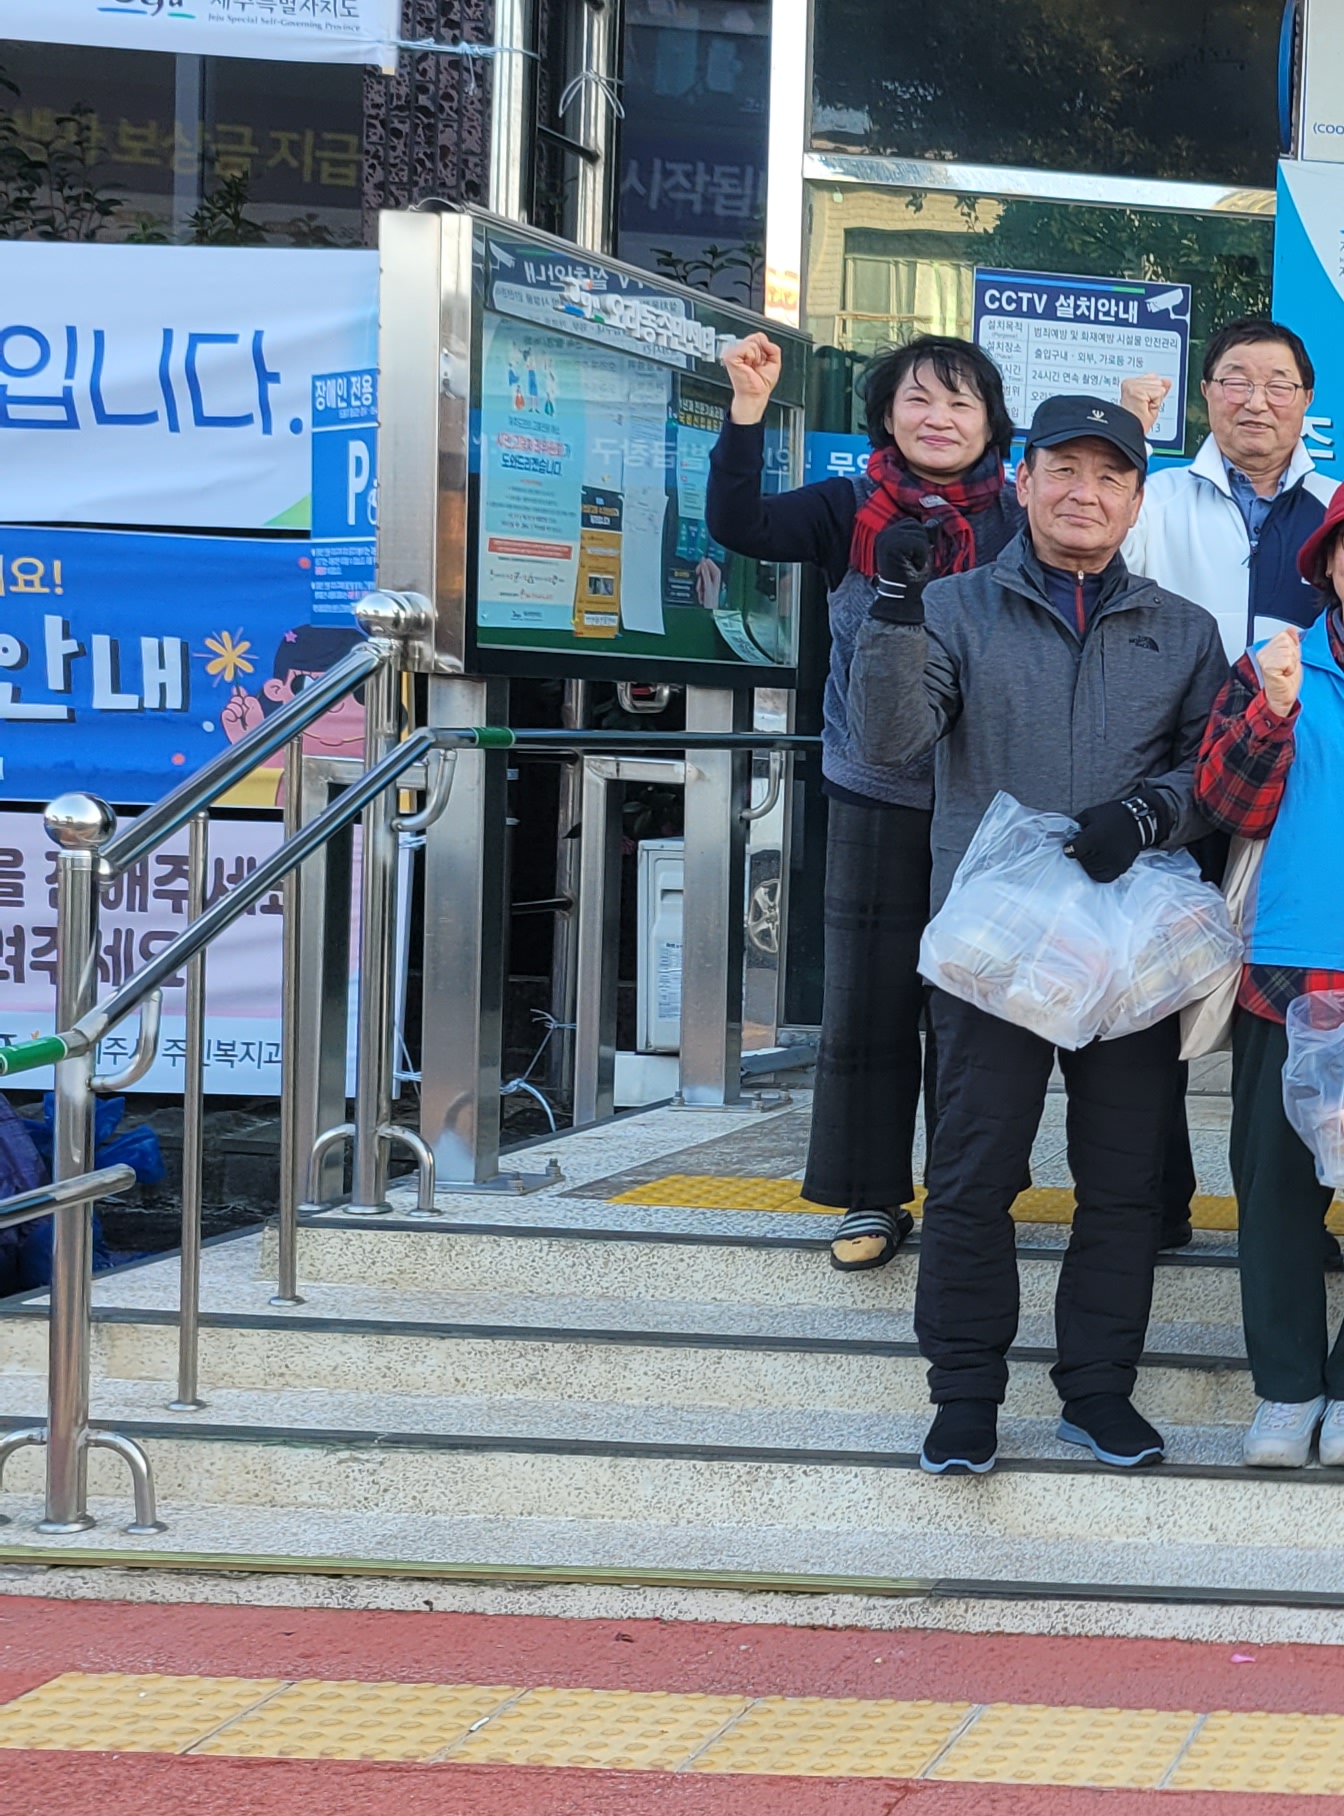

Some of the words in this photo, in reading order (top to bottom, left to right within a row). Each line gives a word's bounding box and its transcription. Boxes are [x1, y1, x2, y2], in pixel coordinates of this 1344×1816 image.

[984, 289, 1048, 315] CCTV
[1055, 294, 1139, 325] 설치안내
[350, 374, 374, 408] 전용
